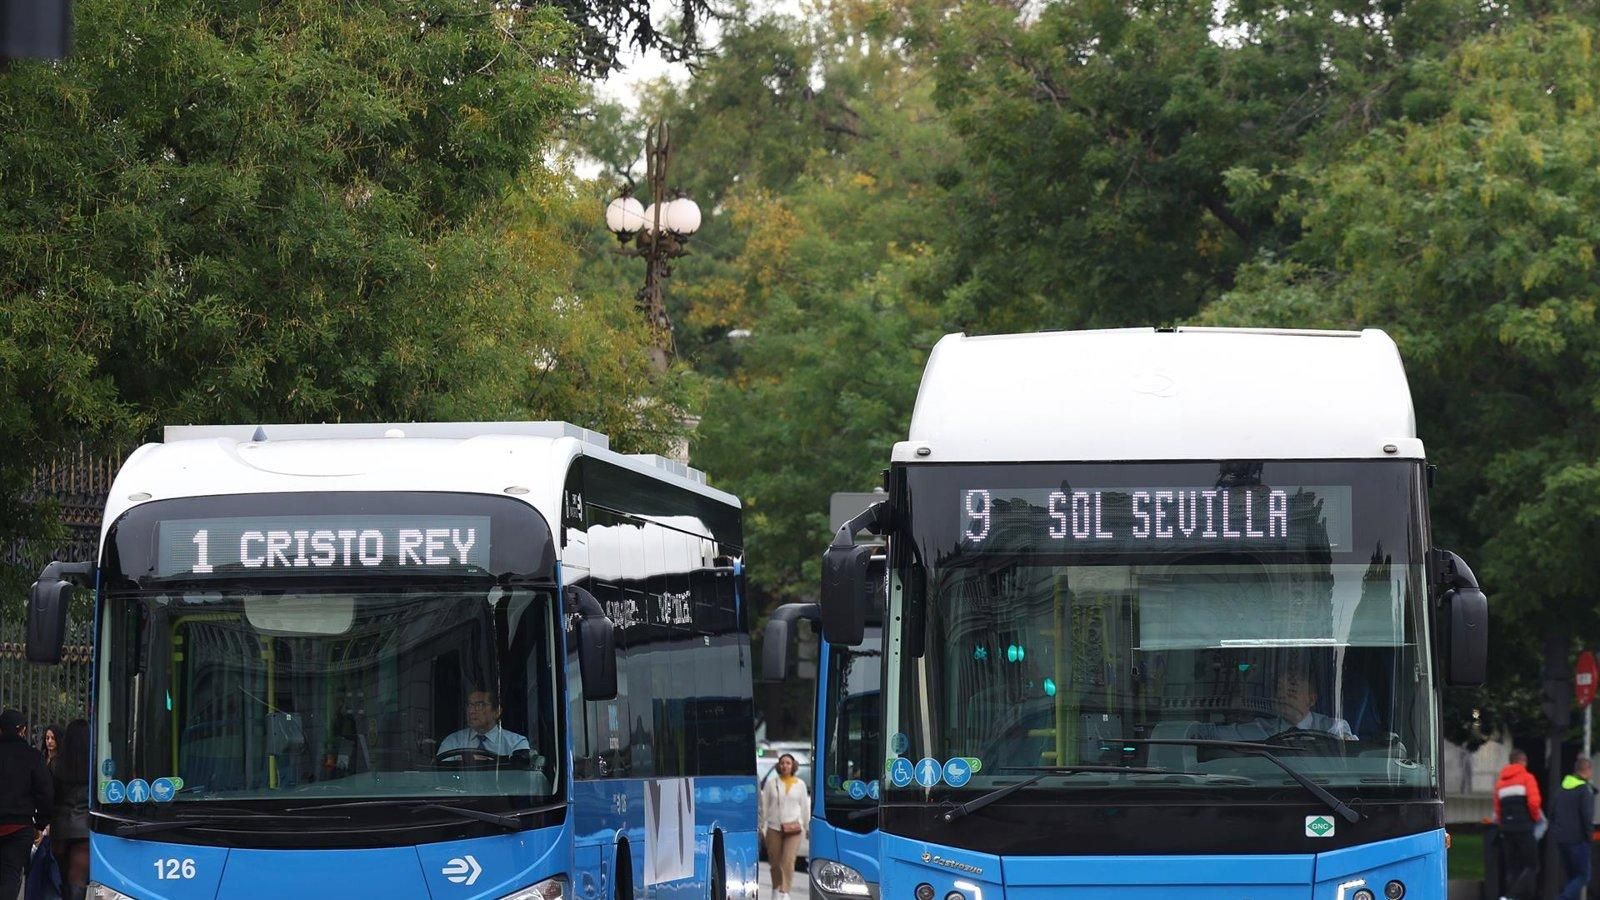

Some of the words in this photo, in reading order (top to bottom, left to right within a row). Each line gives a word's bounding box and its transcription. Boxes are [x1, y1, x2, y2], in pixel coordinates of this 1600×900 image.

[966, 489, 990, 542] 9
[1049, 491, 1113, 539] SOL
[1132, 490, 1287, 538] SEVILLA
[192, 529, 213, 573] 1
[240, 529, 383, 567] CRISTO
[399, 528, 475, 565] REY
[153, 858, 196, 880] 126
